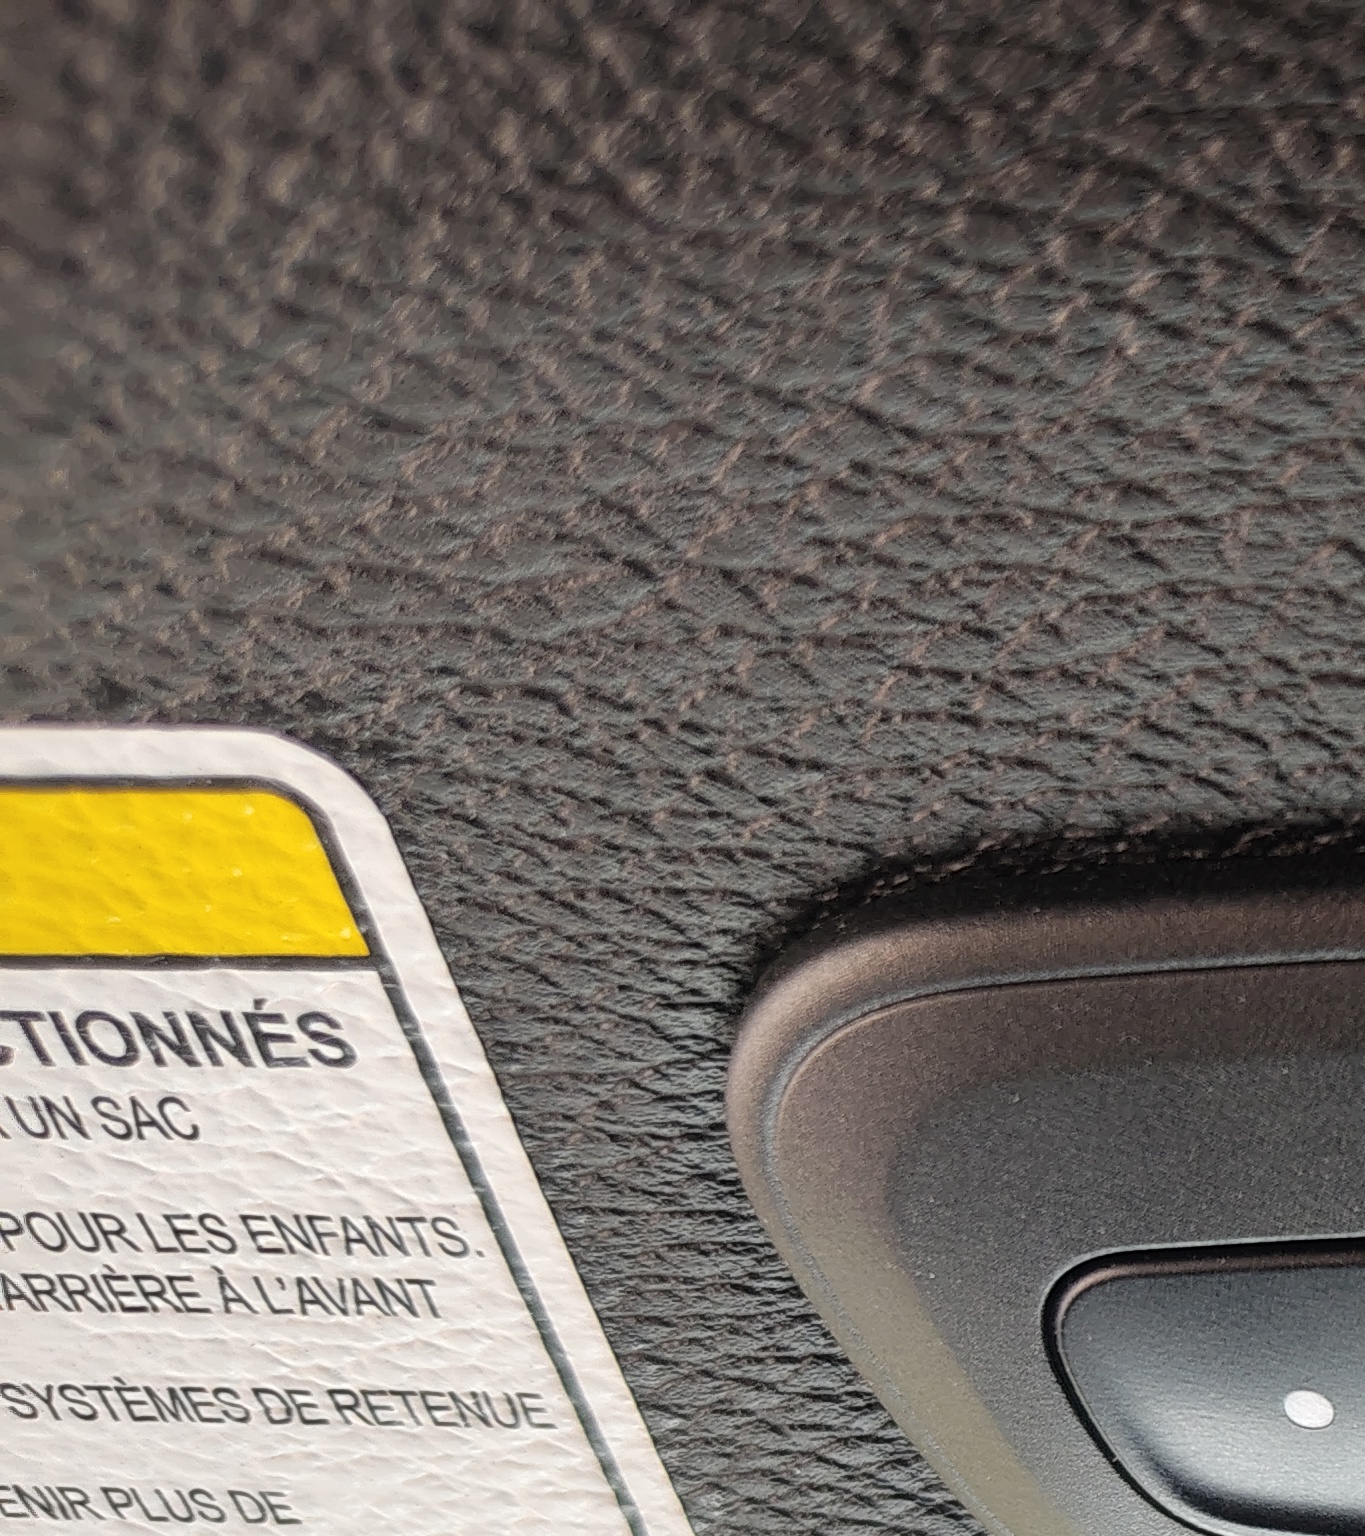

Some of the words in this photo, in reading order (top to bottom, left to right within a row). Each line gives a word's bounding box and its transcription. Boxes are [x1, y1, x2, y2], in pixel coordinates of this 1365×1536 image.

[0, 998, 358, 1068] TIONNÉS
[5, 1095, 92, 1140] UN
[90, 1095, 200, 1141] SAC
[0, 1211, 143, 1253] POUR
[136, 1212, 238, 1255] LES
[241, 1214, 486, 1259] ENFANTS.
[211, 1265, 260, 1315] À
[256, 1277, 443, 1318] L'AVANT
[0, 1376, 250, 1423] SYSTÈMES
[251, 1387, 330, 1426] DE
[328, 1388, 557, 1430] RETENUE
[100, 1486, 227, 1523] PLUS
[227, 1489, 302, 1525] DE
